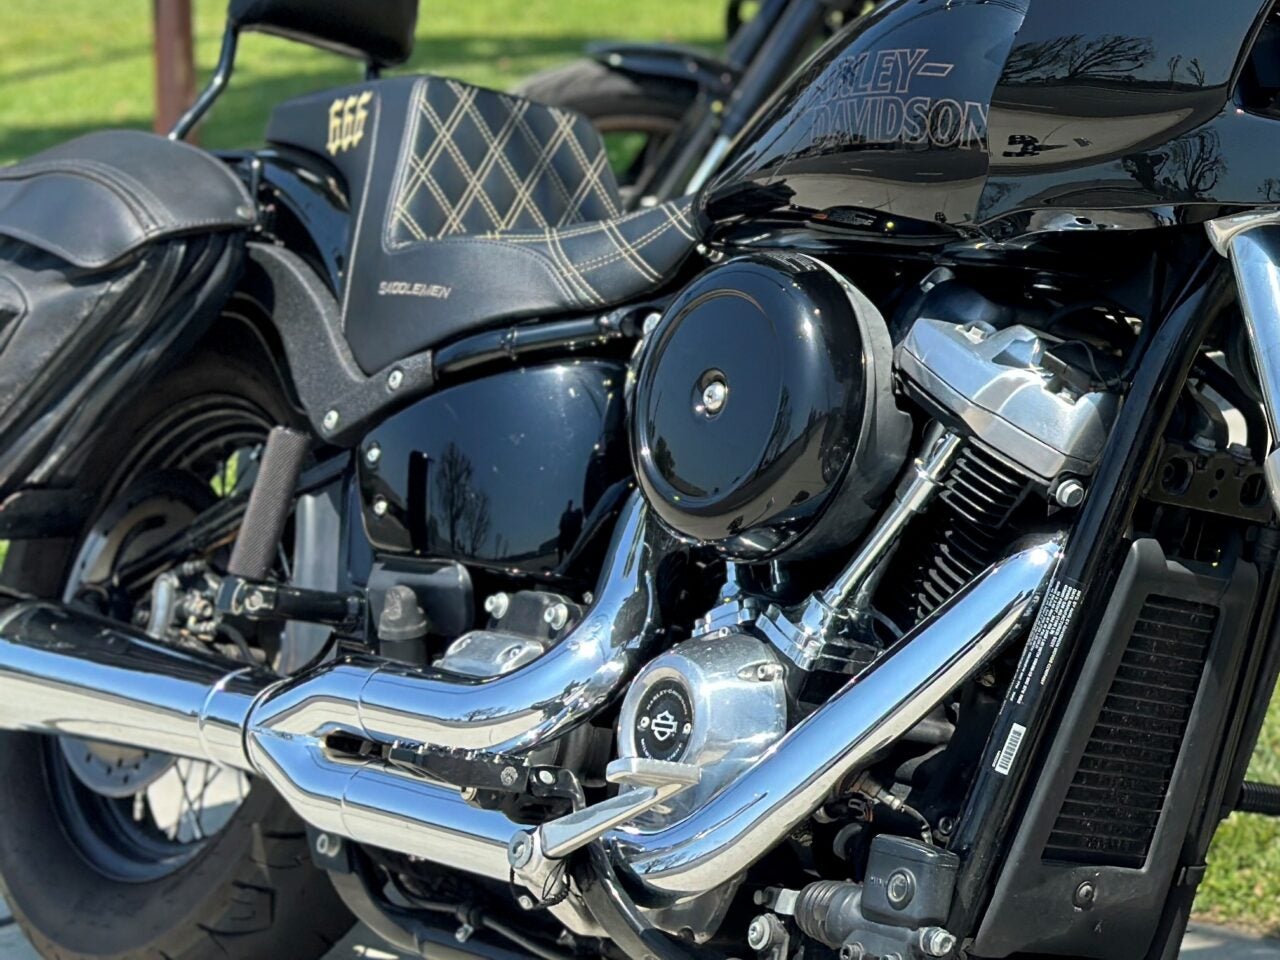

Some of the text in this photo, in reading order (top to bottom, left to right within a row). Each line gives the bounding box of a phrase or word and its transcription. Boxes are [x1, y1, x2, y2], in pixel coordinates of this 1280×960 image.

[326, 90, 374, 156] 666
[810, 95, 990, 152] DAVIDSON
[378, 280, 452, 300] SADDLEMEN
